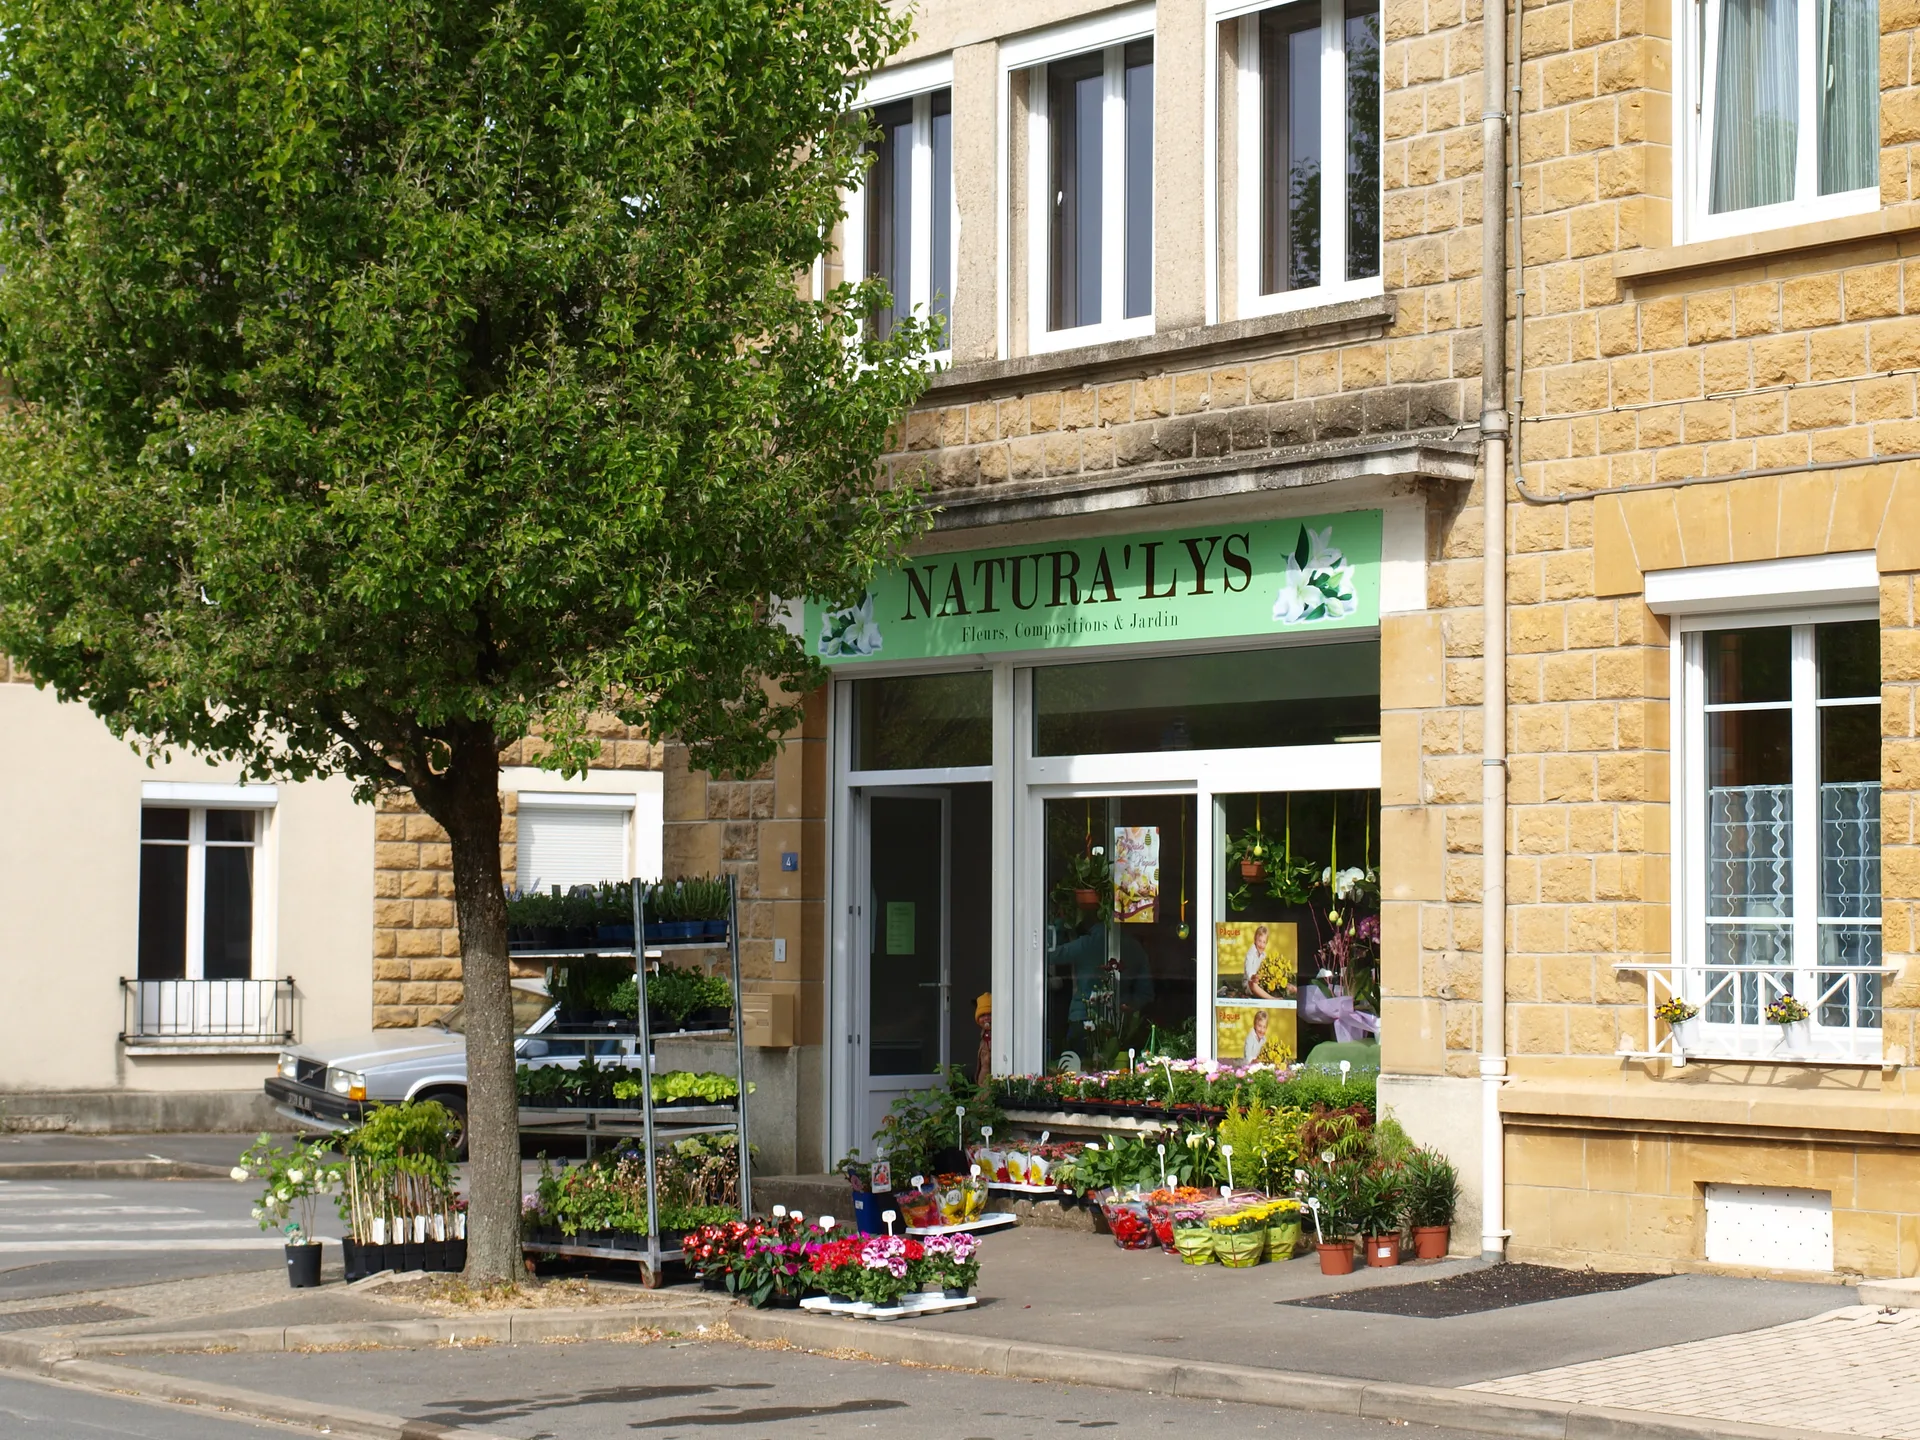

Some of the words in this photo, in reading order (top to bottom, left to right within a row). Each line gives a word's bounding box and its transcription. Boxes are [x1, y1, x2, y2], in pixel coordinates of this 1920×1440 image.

[901, 532, 1252, 620] NATURA'LYS
[962, 626, 1009, 642] Fleurs,
[1015, 616, 1108, 640] Compositions
[1114, 614, 1123, 630] &
[1130, 611, 1178, 629] Jardin
[786, 857, 791, 866] 4
